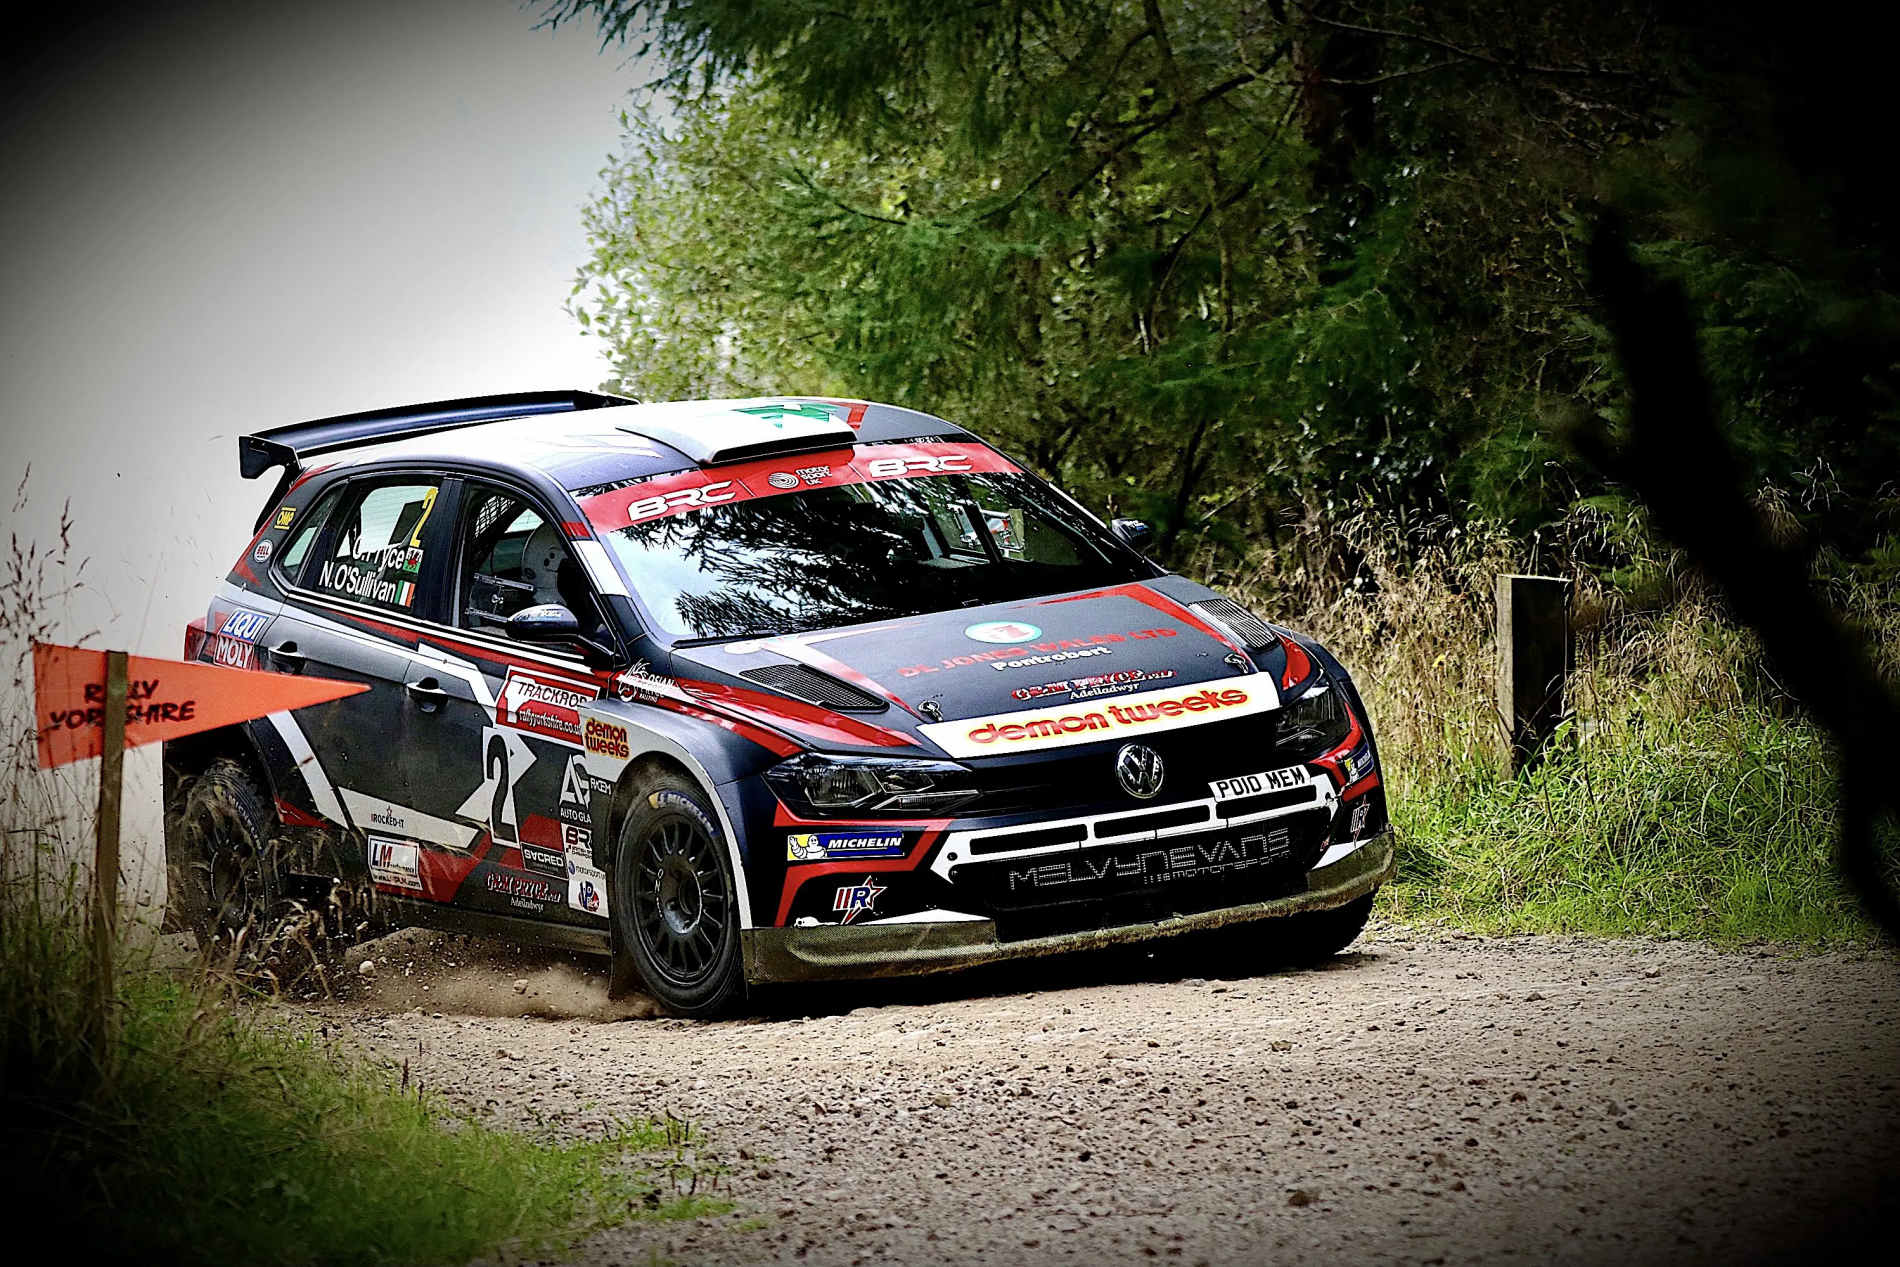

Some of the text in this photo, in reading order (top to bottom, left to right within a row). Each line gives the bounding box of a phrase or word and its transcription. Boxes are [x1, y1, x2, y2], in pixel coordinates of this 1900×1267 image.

[795, 465, 829, 475] motor
[800, 471, 832, 480] sport
[868, 455, 972, 477] BRC
[627, 480, 736, 521] BRC
[409, 487, 439, 548] 2
[222, 610, 267, 640] LIQUI
[215, 639, 254, 669] MOLY
[898, 663, 939, 678] DL
[942, 646, 1029, 670] JONES
[1128, 628, 1178, 641] LTD
[990, 646, 1113, 671] Pontrobert
[83, 679, 160, 704] RLY
[50, 700, 196, 729] YORSHIRE
[969, 689, 1249, 744] demon tweeks
[585, 717, 628, 743] demon
[584, 732, 629, 758] tweeks
[486, 733, 518, 843] 2
[1215, 767, 1306, 799] PO10 MEM
[560, 807, 578, 820] AUTO
[827, 836, 902, 849] MICHELIN
